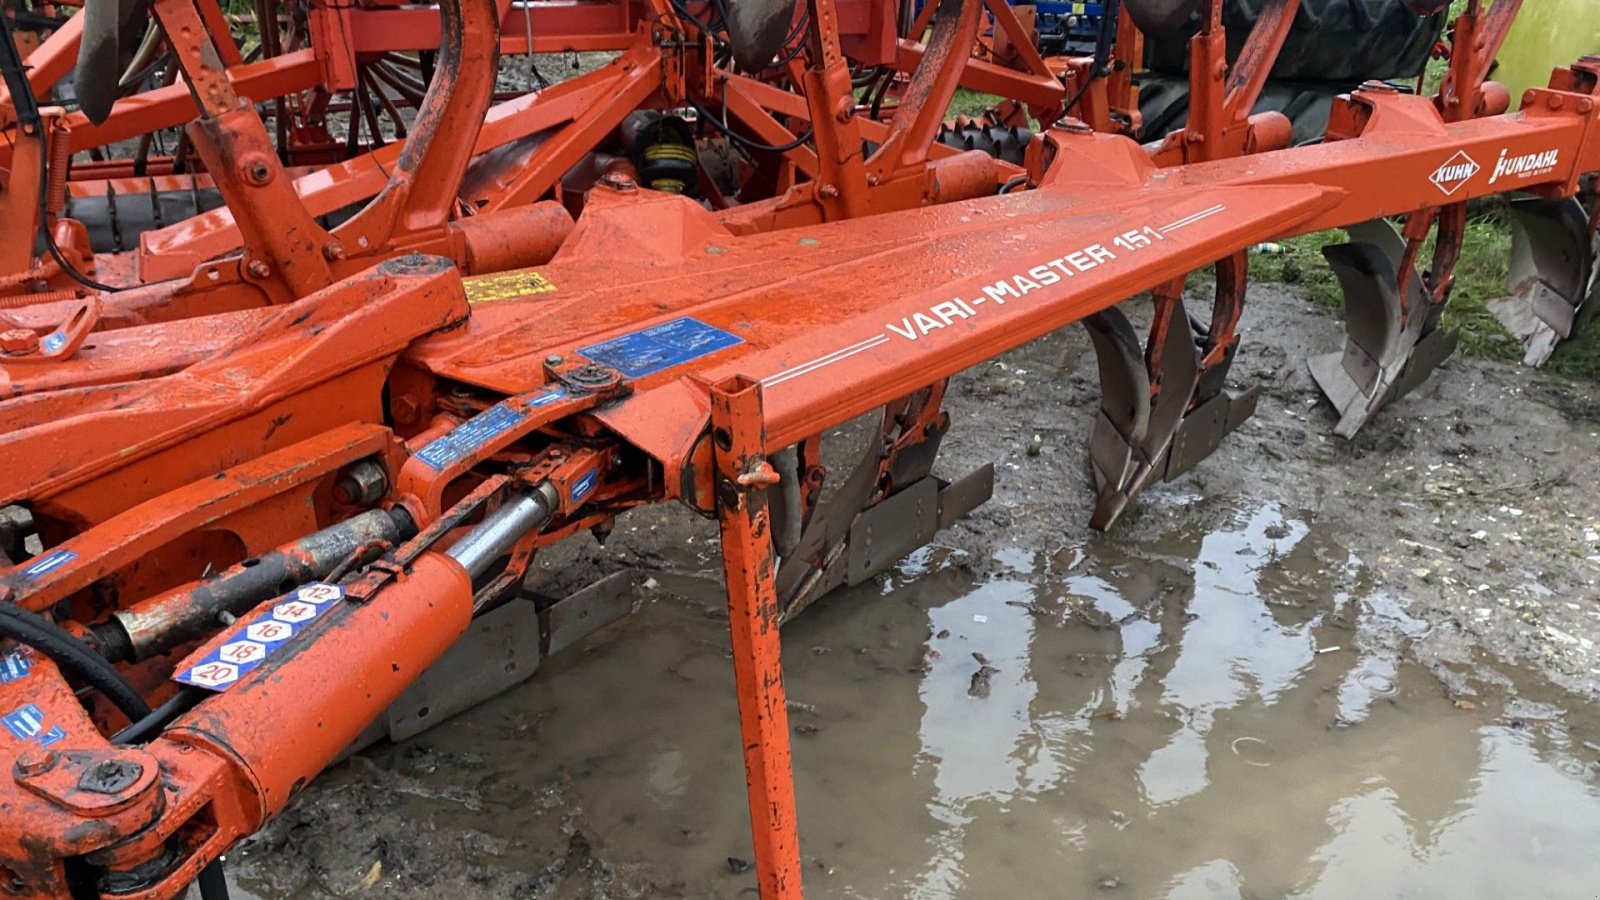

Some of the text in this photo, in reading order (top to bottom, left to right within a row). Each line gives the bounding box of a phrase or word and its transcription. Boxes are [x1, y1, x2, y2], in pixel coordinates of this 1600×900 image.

[1435, 162, 1474, 184] KUHN
[885, 225, 1165, 342] VARI-MASTER 151
[307, 586, 331, 600] 12
[280, 604, 308, 618] 14
[256, 622, 282, 638] 16
[226, 643, 257, 659] 18
[196, 663, 233, 682] 20
